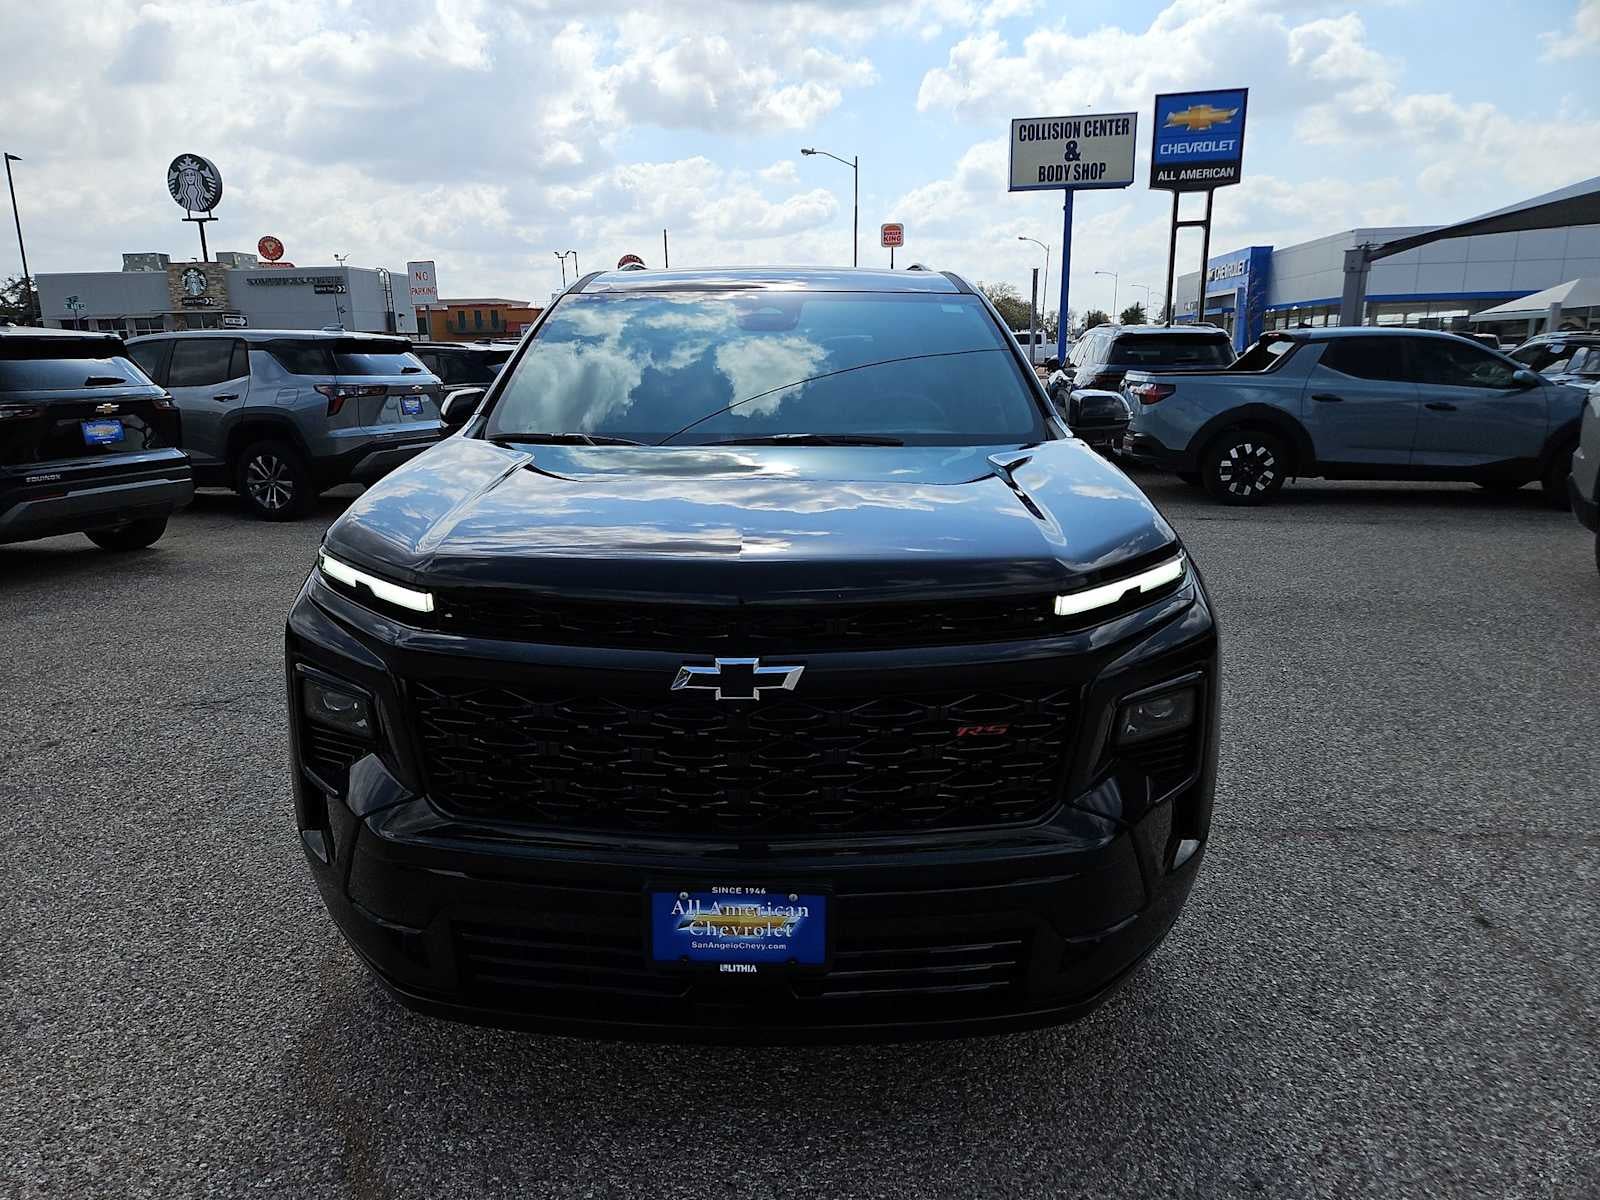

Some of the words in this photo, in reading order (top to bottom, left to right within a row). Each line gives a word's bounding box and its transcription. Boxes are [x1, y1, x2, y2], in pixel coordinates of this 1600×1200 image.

[1019, 121, 1081, 141] COLLISION
[1084, 118, 1130, 138] CENTER
[1064, 140, 1081, 162] &
[1160, 139, 1236, 155] CHEVROLET
[1038, 164, 1071, 182] BODY
[1073, 162, 1107, 181] SHOP
[1157, 170, 1177, 181] ALL
[1179, 167, 1235, 180] AMERICAN
[415, 272, 429, 281] NO
[410, 286, 436, 296] PARKING
[955, 725, 1008, 737] RS
[671, 899, 701, 916] All
[710, 901, 809, 917] American
[689, 920, 793, 938] Chevrolet
[691, 941, 787, 950] SanAngeloChevy.com
